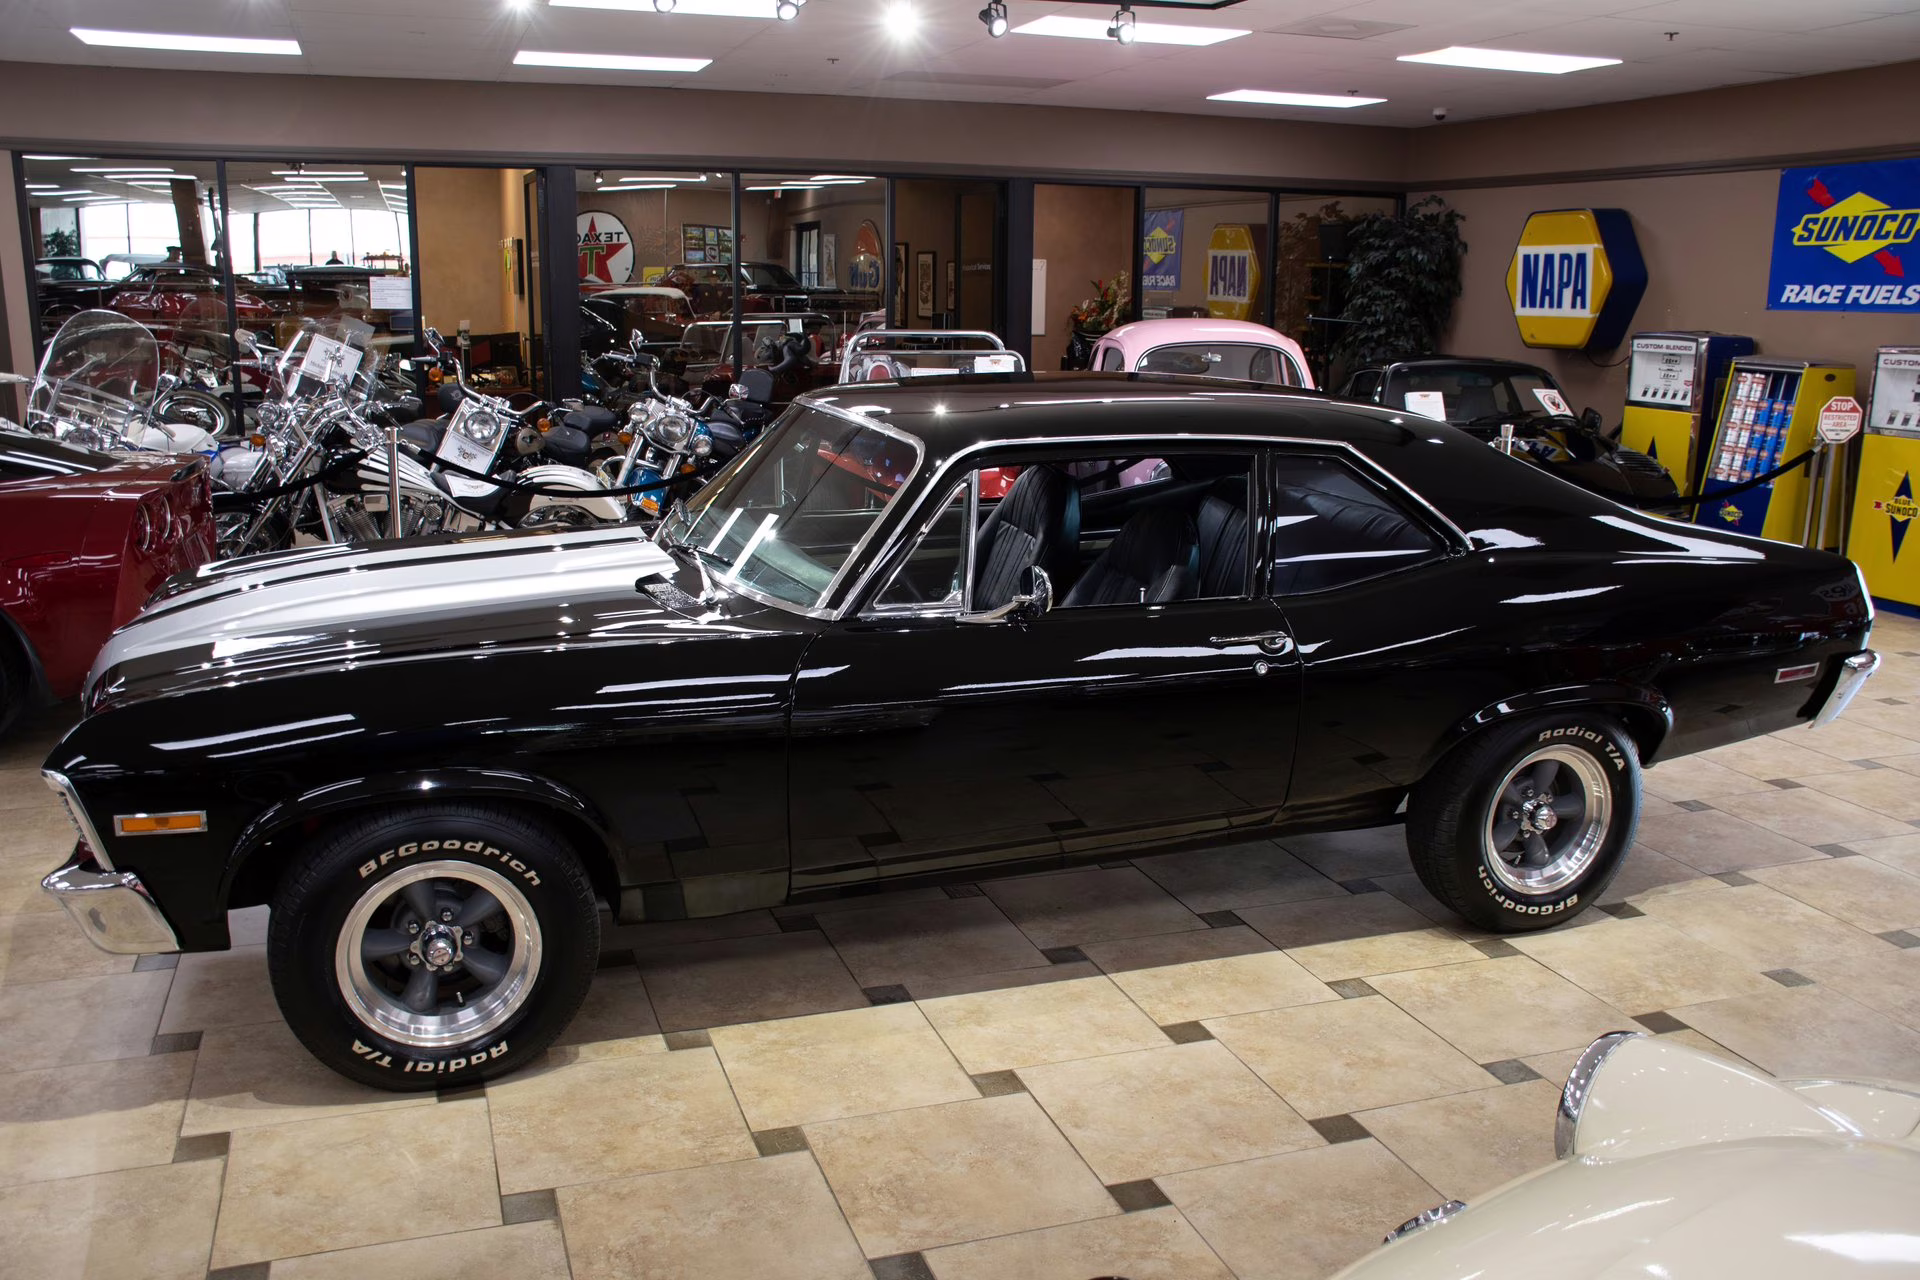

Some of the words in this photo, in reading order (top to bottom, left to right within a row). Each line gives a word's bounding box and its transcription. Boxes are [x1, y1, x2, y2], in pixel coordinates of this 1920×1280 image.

[1797, 212, 1920, 242] SUNOCO
[1521, 253, 1587, 310] NAPA
[1780, 284, 1847, 304] RACE
[1845, 284, 1920, 305] FUELS
[1831, 401, 1854, 411] STOP
[1886, 503, 1919, 518] SUNOCO
[1538, 726, 1603, 743] Radial
[1603, 742, 1627, 772] T/A
[358, 839, 541, 887] BFGoodrich
[1477, 865, 1579, 916] BFGoodrich
[352, 1039, 393, 1069] T/A
[404, 1040, 509, 1075] Radial
